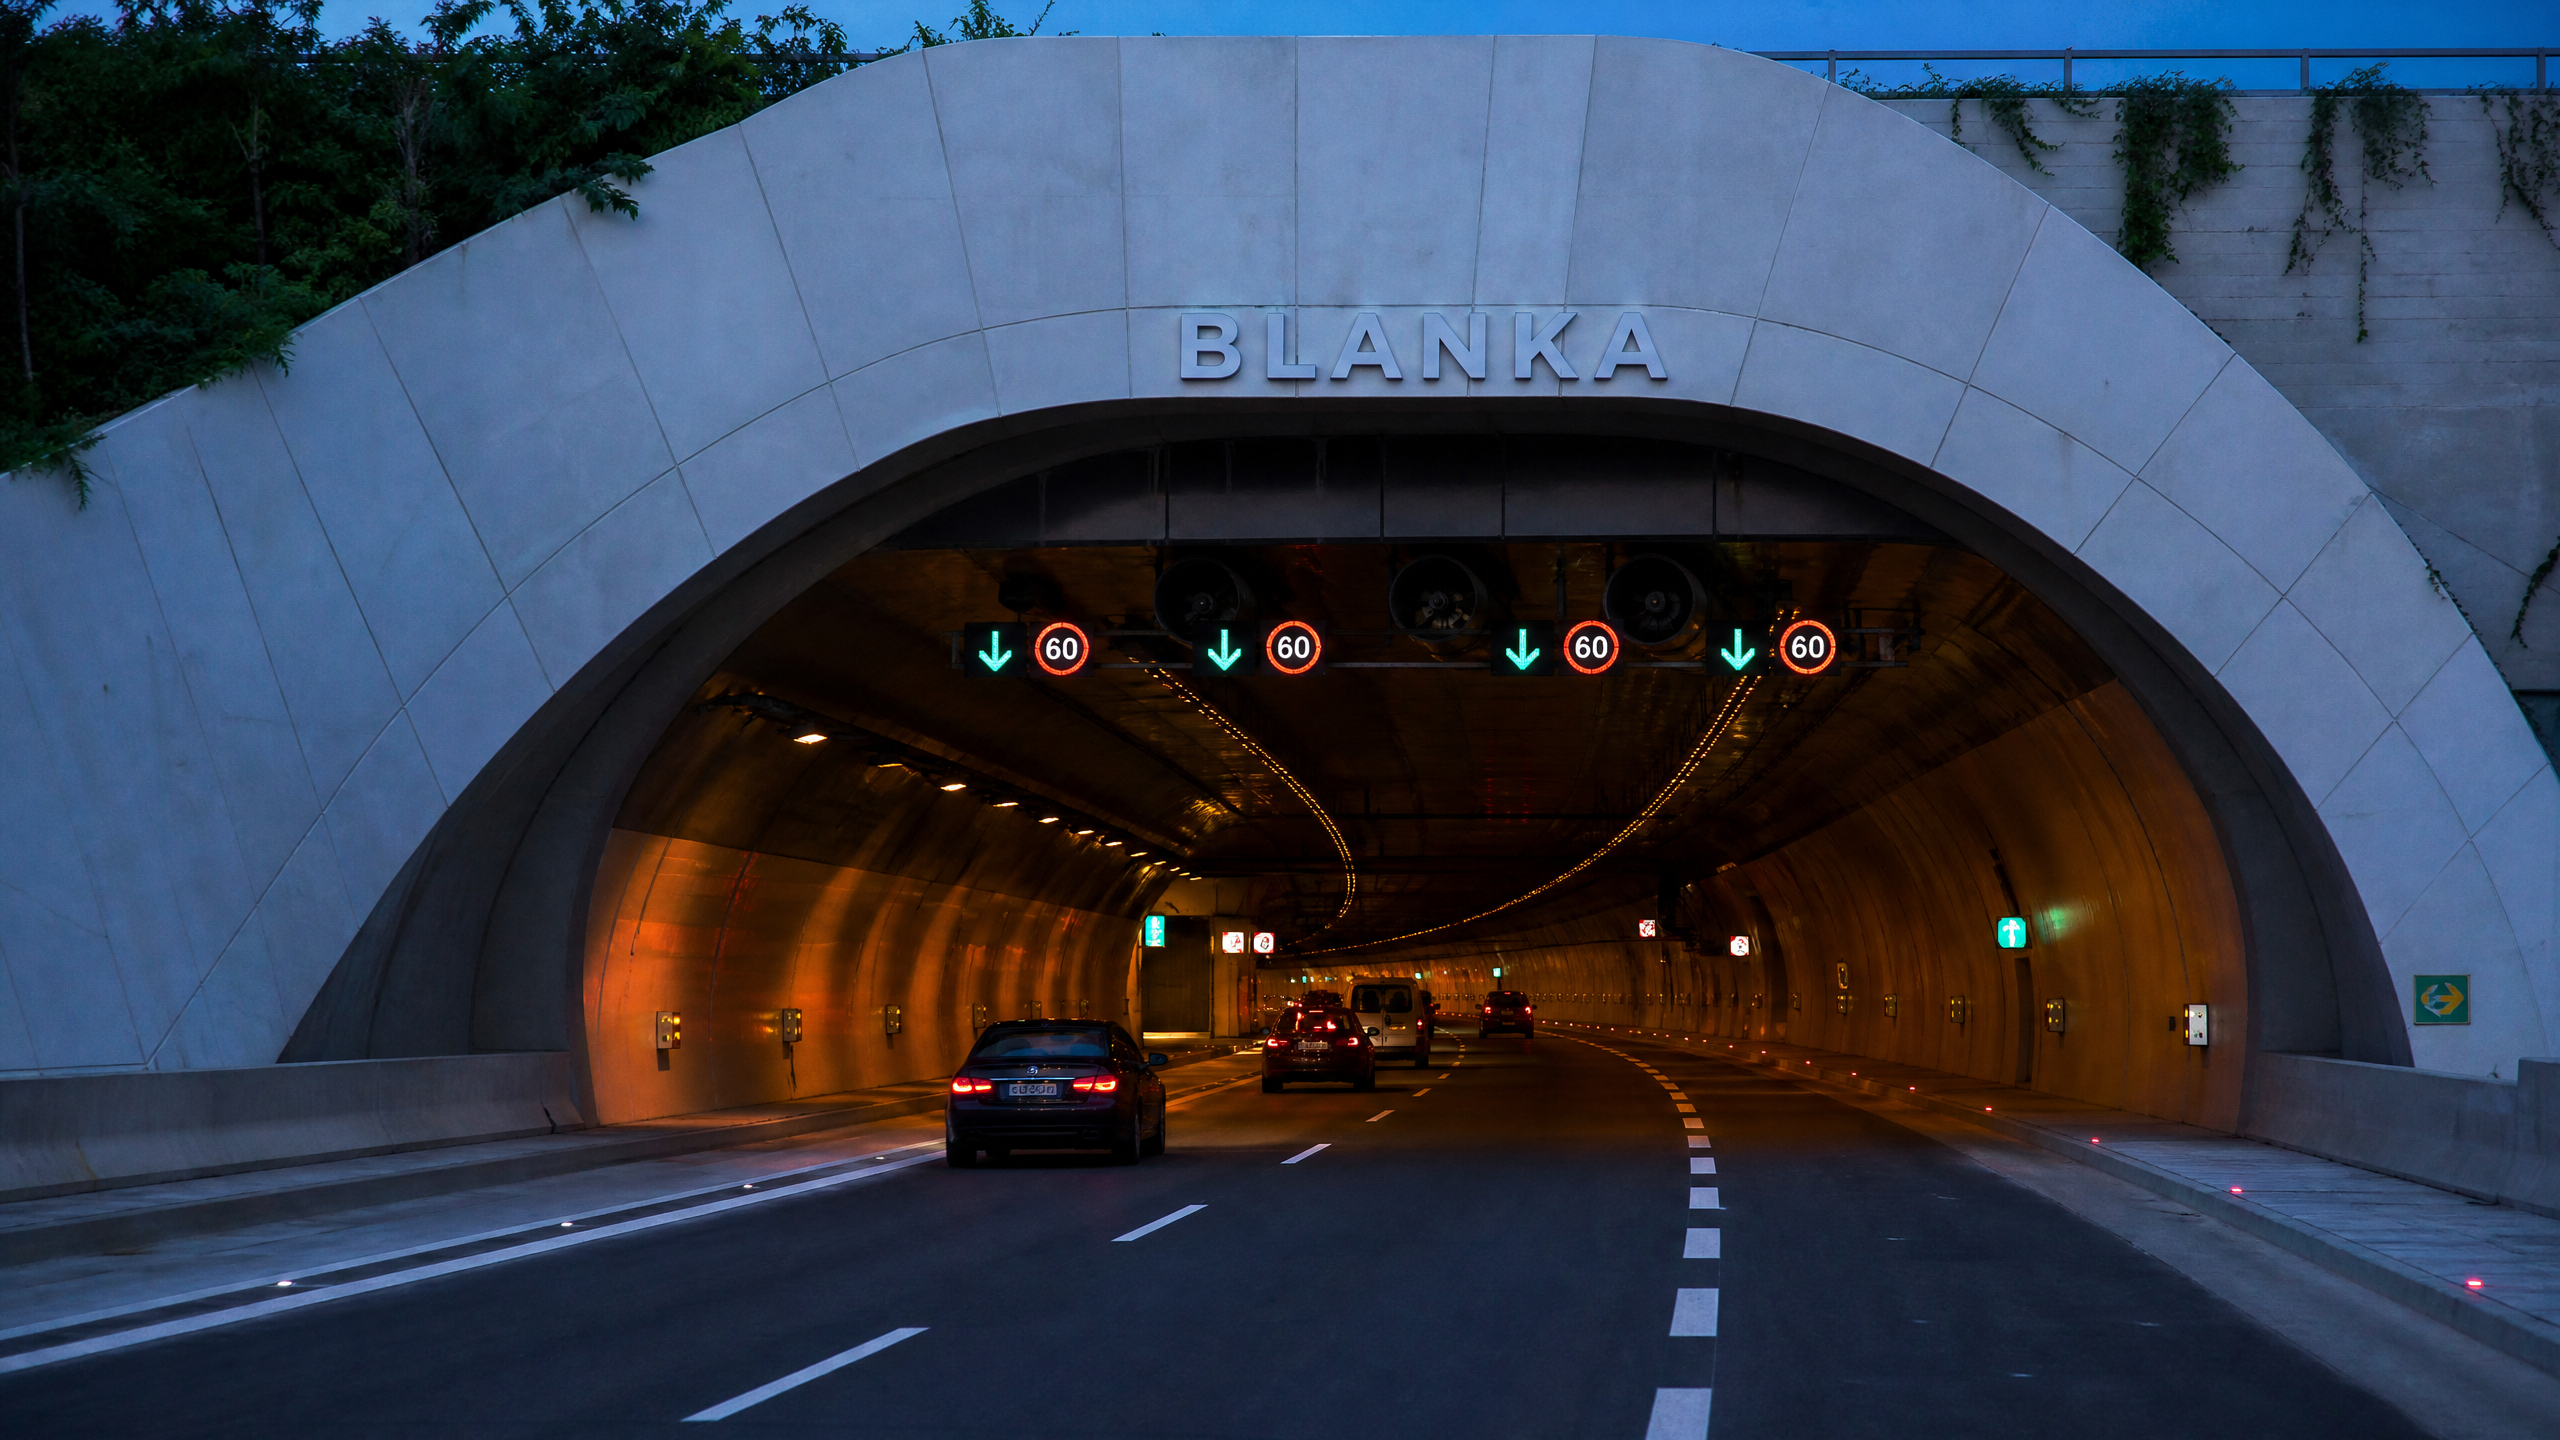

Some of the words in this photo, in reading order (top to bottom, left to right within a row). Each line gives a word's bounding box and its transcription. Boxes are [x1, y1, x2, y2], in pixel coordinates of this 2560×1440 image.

[1180, 311, 1668, 381] BLANKA
[1045, 636, 1078, 660] 60
[1277, 635, 1310, 659] 60
[1574, 635, 1608, 659] 60
[1791, 635, 1825, 659] 60
